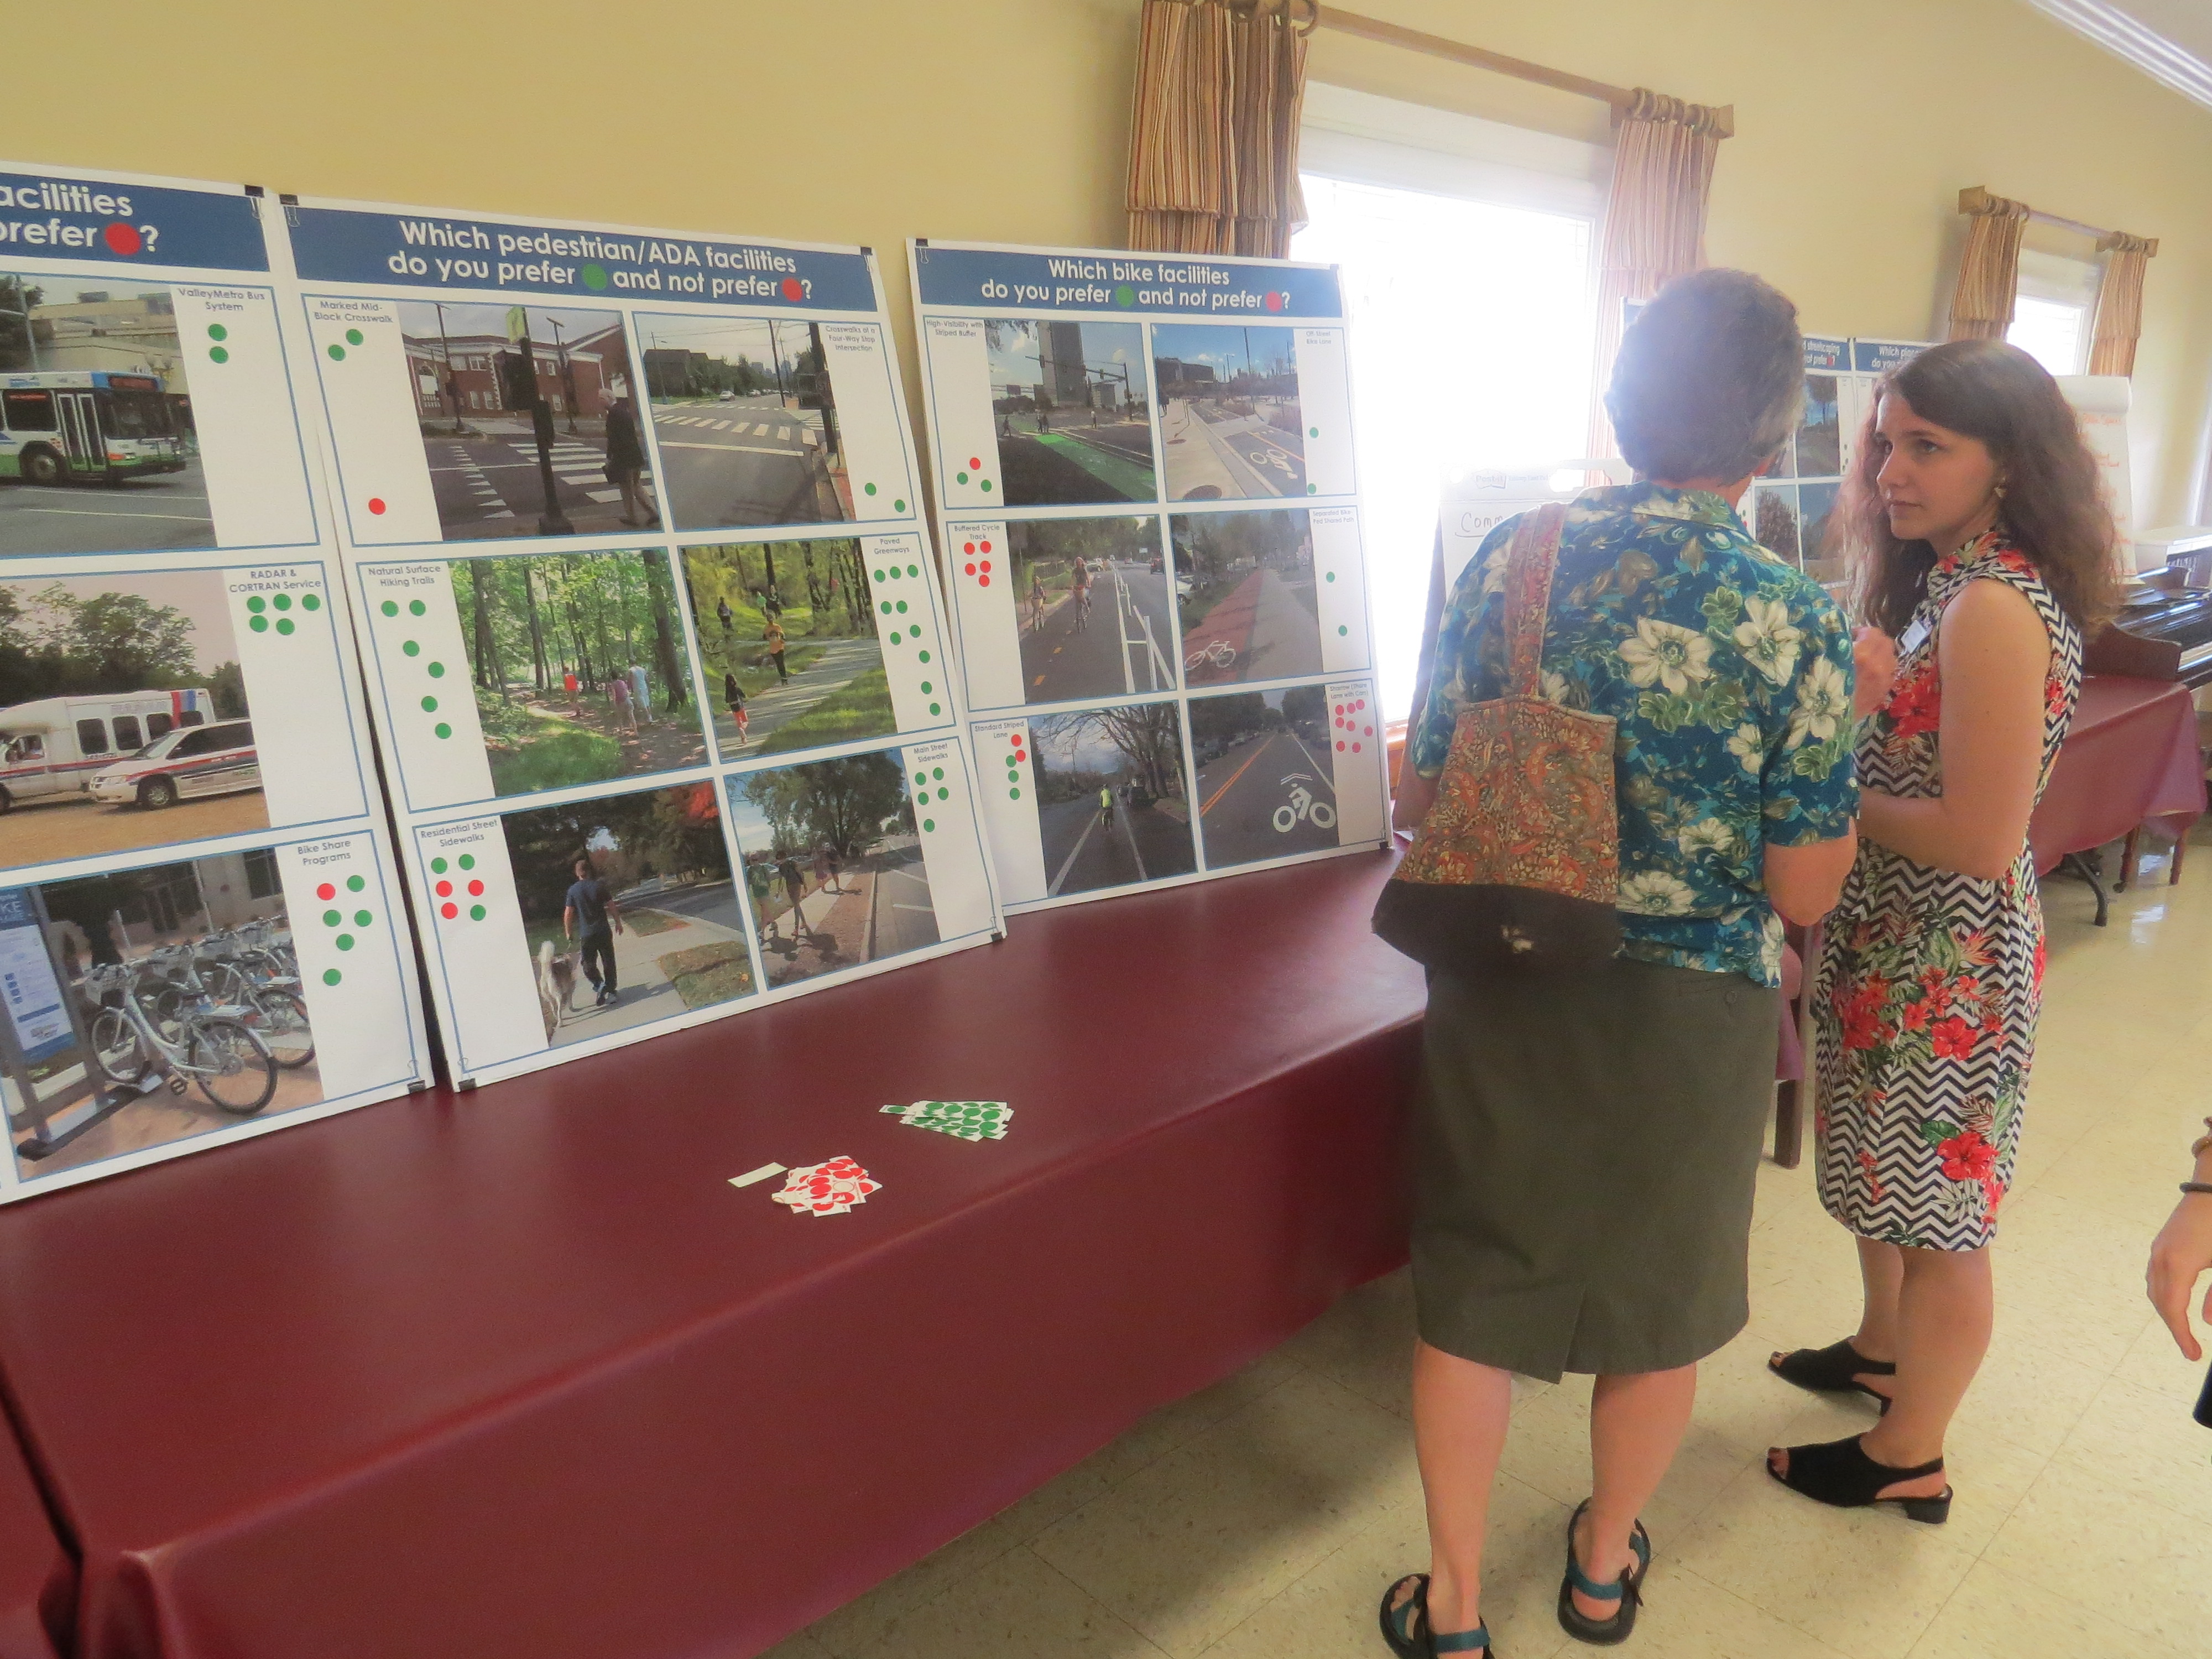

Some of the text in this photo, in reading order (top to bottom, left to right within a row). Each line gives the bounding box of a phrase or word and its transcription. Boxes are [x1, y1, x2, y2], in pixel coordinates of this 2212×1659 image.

[139, 225, 159, 253] ?
[399, 220, 796, 274] Which pedestrian/ADA facilities
[389, 251, 812, 299] do you prefer and not prefer ?
[1048, 259, 1230, 285] Which bike facilities
[179, 287, 265, 300] ValleyMetro Bus
[982, 278, 1291, 310] do you prefer and not prefer ?
[206, 301, 243, 312] System
[320, 301, 358, 311] Marked
[314, 312, 394, 324] Block Crosswalk
[251, 569, 286, 578] RADAR
[368, 565, 441, 575] Natural Surface
[229, 580, 321, 592] CORTRAN Service
[380, 577, 410, 587] Hiking
[974, 721, 1024, 732] Standard Striped
[914, 743, 948, 754] Main Street
[917, 753, 948, 763] Sidewalks
[420, 819, 498, 839] Residential Street
[439, 833, 484, 847] Sidewalks
[297, 839, 351, 855] Bike Share
[302, 851, 351, 866] Programs
